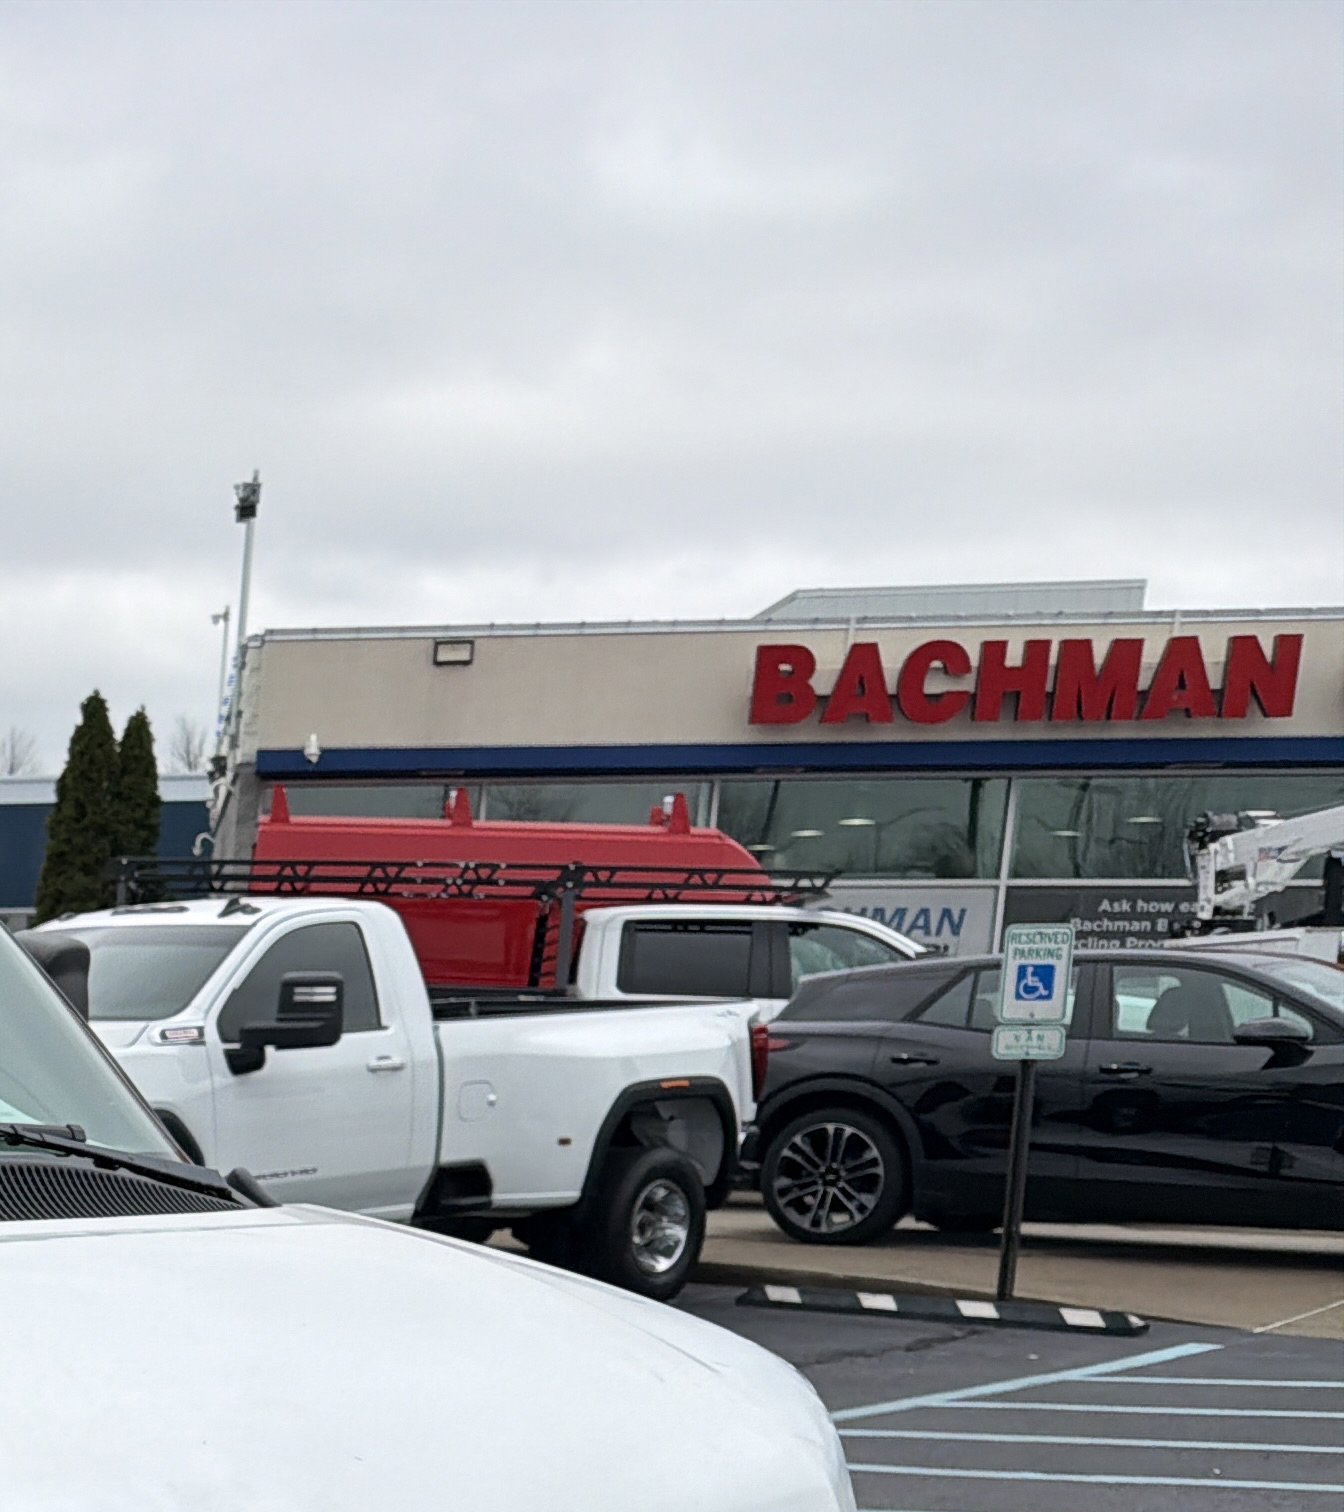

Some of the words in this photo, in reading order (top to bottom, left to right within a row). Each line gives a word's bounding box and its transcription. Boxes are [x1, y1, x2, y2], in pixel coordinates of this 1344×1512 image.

[750, 634, 1303, 725] BACHMAN
[1097, 899, 1131, 913] Ask
[1136, 899, 1174, 913] how
[1071, 918, 1151, 932] Bachman
[1011, 931, 1069, 945] RESERVED
[1013, 948, 1062, 960] PARKING
